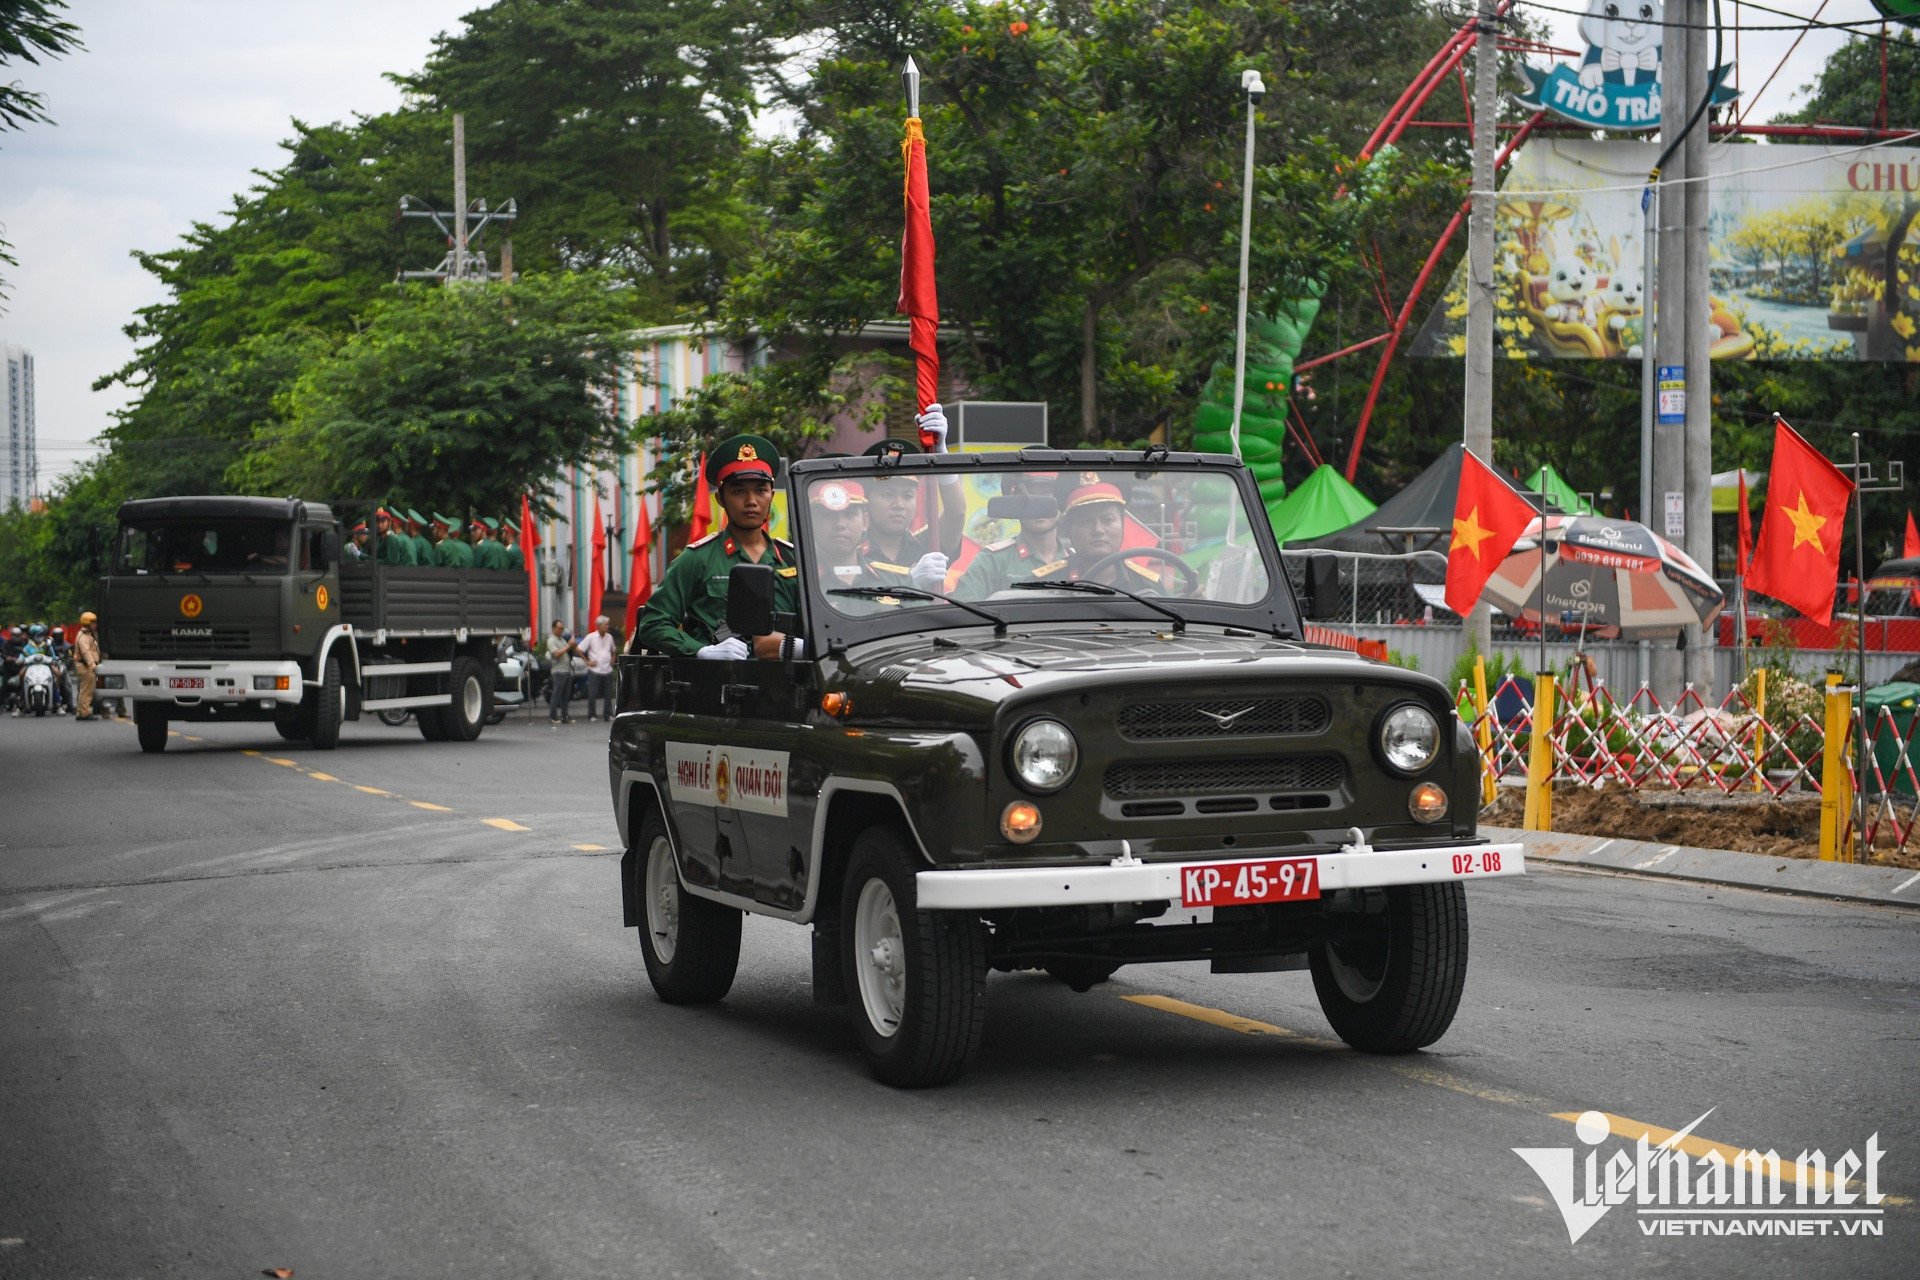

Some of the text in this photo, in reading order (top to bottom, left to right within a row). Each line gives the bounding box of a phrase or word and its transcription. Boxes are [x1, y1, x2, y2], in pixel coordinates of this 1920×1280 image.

[1553, 79, 1608, 118] THỎ
[1847, 156, 1920, 192] CHÚ
[1602, 555, 1622, 567] 618
[1625, 558, 1644, 571] 181
[171, 628, 213, 637] KAMAZ
[170, 678, 204, 688] KP-50-25
[677, 750, 782, 805] NGHI LỄ QUÂN ĐỘI
[1451, 852, 1502, 875] 02-08
[1185, 862, 1313, 903] KP-45-97
